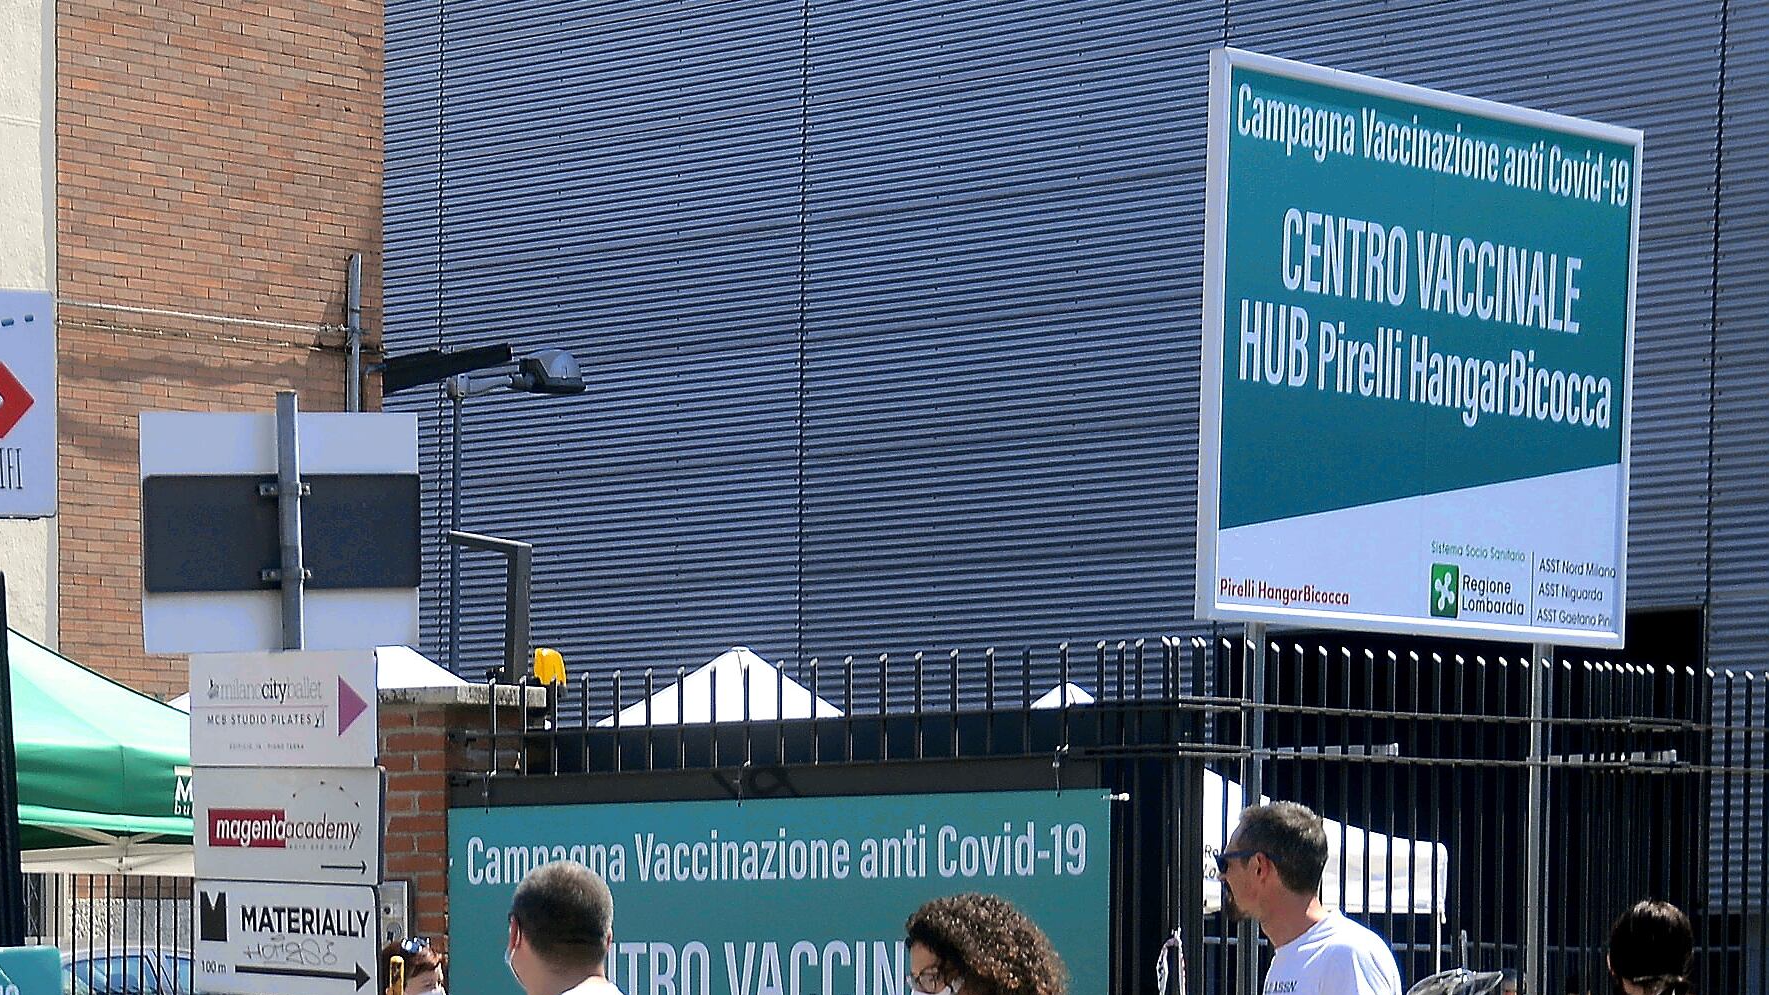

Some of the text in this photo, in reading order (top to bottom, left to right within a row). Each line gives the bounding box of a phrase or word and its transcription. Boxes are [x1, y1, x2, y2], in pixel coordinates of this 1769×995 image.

[1237, 83, 1630, 208] Campagna Vaccinazione anti Covid-19
[1282, 207, 1582, 334] CENTRO VACCINALE
[1238, 298, 1612, 430] HUB Pirelli HangarBicocca
[1431, 540, 1463, 557] Sistema
[1466, 543, 1488, 559] Socio
[1539, 558, 1560, 573] ASST
[1562, 559, 1584, 576] Nord
[1219, 577, 1351, 608] Pirelli HangarBicocca
[1462, 574, 1511, 596] Regione
[1538, 582, 1603, 602] ASST Niguarda
[1461, 596, 1525, 616] Lombardia
[1536, 608, 1558, 624] ASST
[1559, 610, 1596, 626] Gaetano
[231, 714, 267, 726] STUDIO
[271, 713, 311, 726] PILATES
[634, 826, 850, 883] Vaccinazione
[859, 824, 927, 879] anti
[937, 821, 1086, 877] Covid-19
[240, 904, 370, 938] MATERIALLY
[201, 959, 227, 973] 100 m
